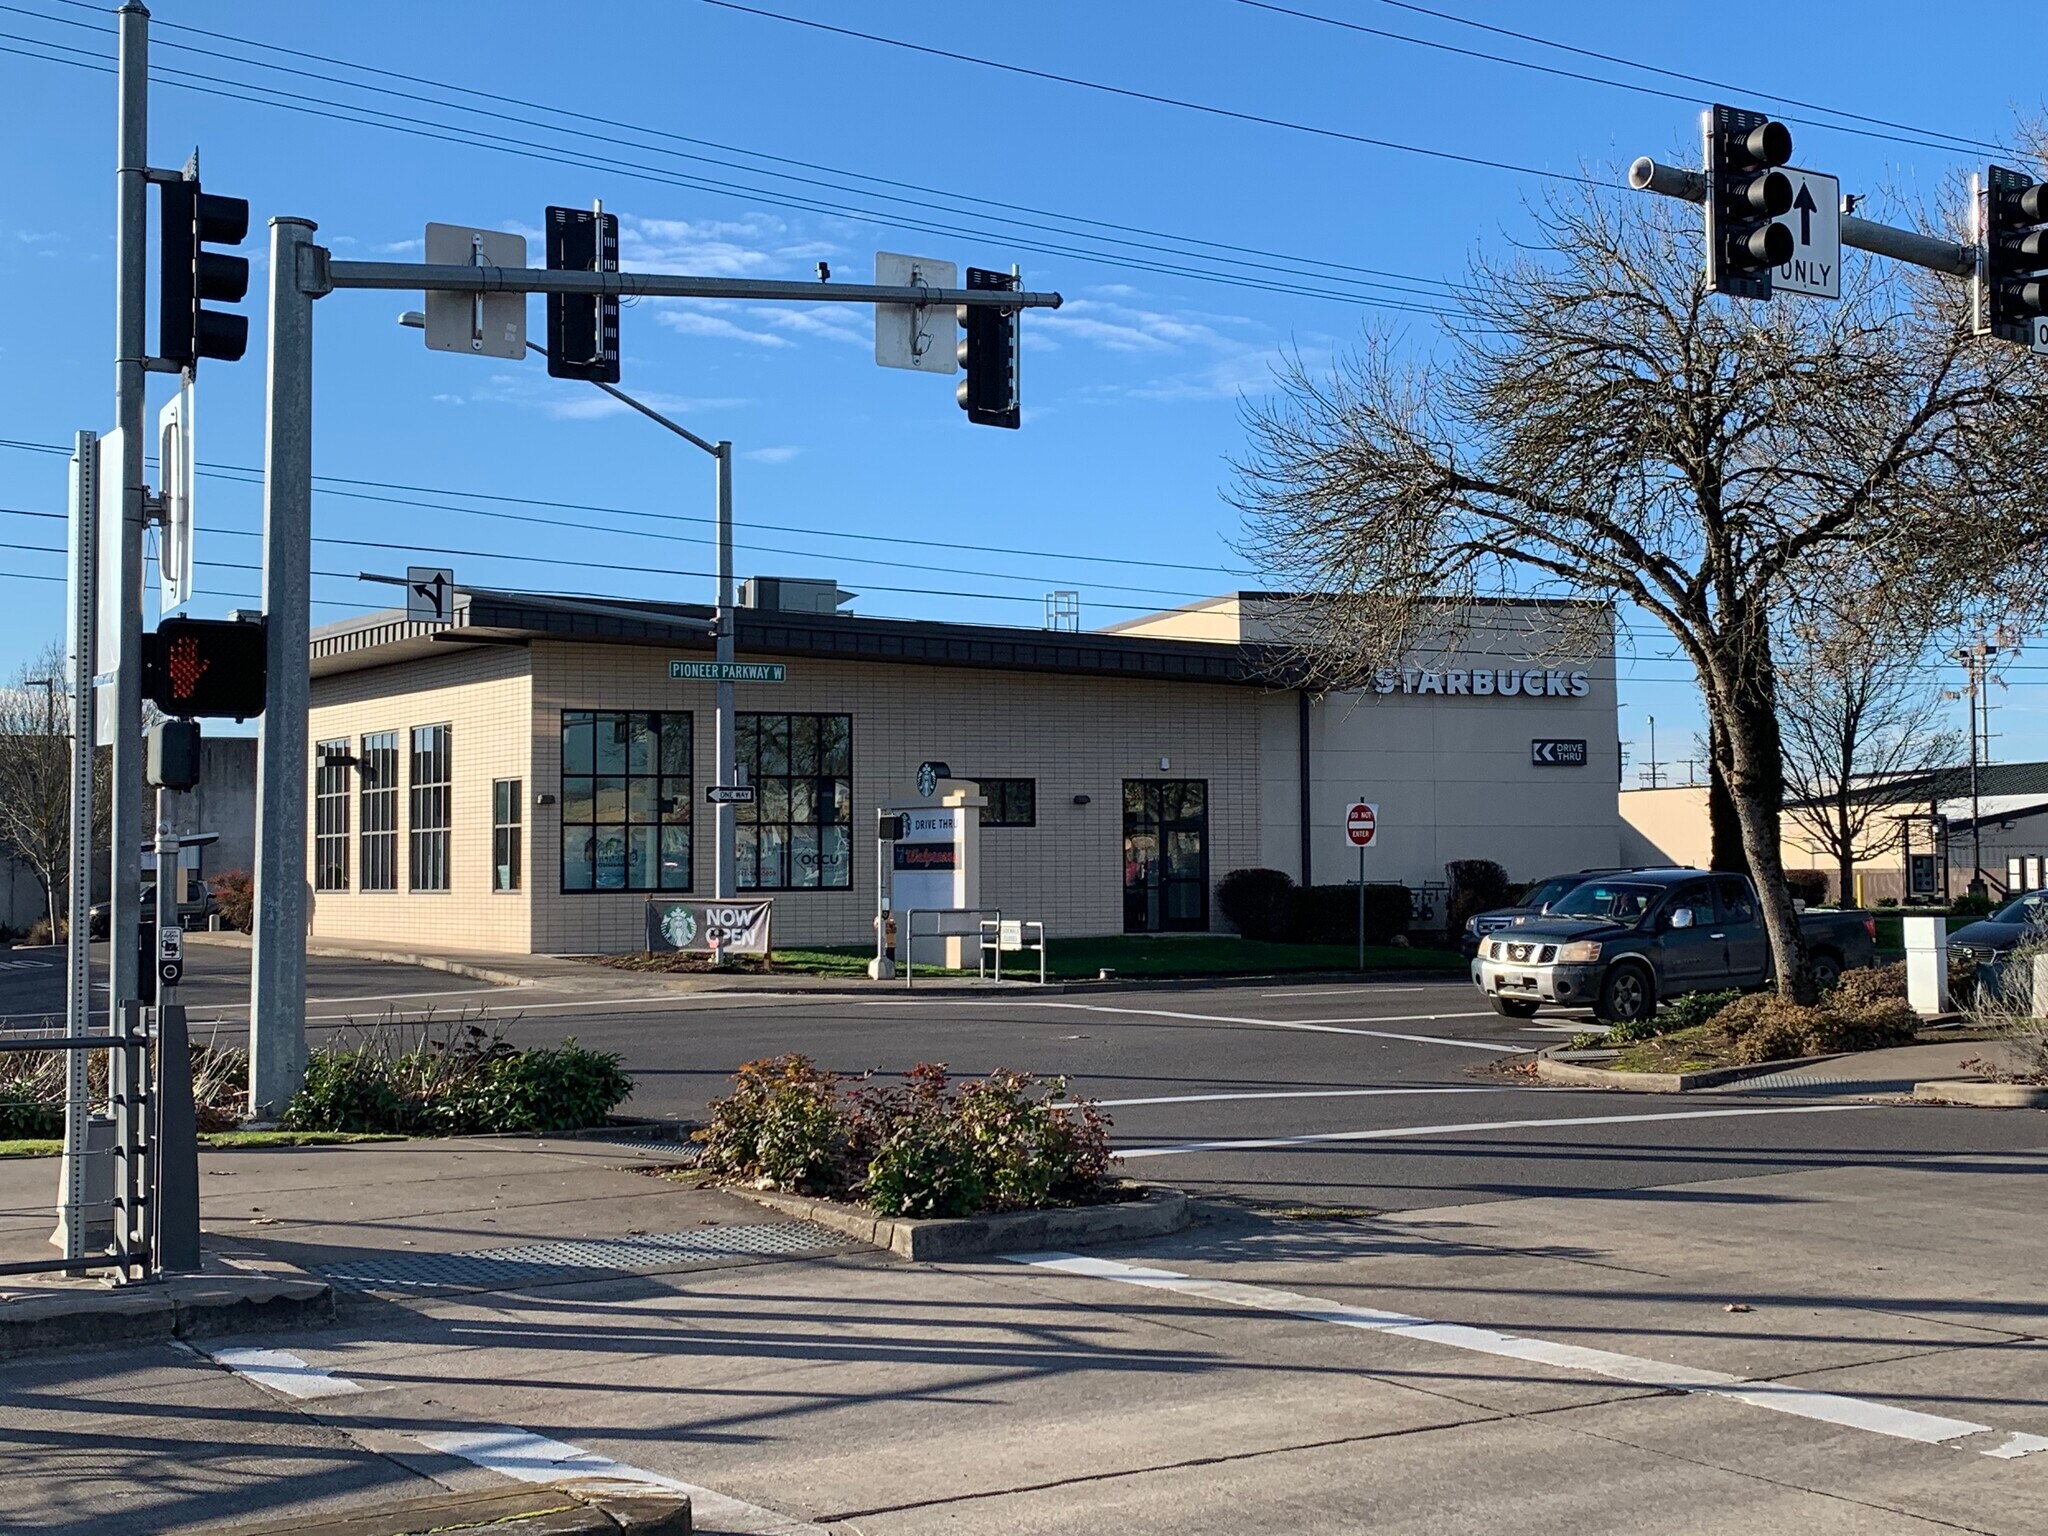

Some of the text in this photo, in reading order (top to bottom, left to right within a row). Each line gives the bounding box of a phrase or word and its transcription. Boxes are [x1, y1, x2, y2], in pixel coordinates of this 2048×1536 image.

[1781, 259, 1831, 287] ONLY
[672, 663, 783, 680] PIONEER PARKWAY W
[1374, 669, 1591, 697] STARBUCKS
[1556, 743, 1583, 753] DRIVE
[1557, 752, 1582, 761] THRU
[720, 791, 749, 799] ONE WAY
[1351, 811, 1371, 819] DO NOT
[915, 818, 959, 830] DRIVE THRU
[1352, 830, 1369, 838] ENTER
[706, 908, 754, 927] NOW
[705, 927, 756, 946] OPEN
